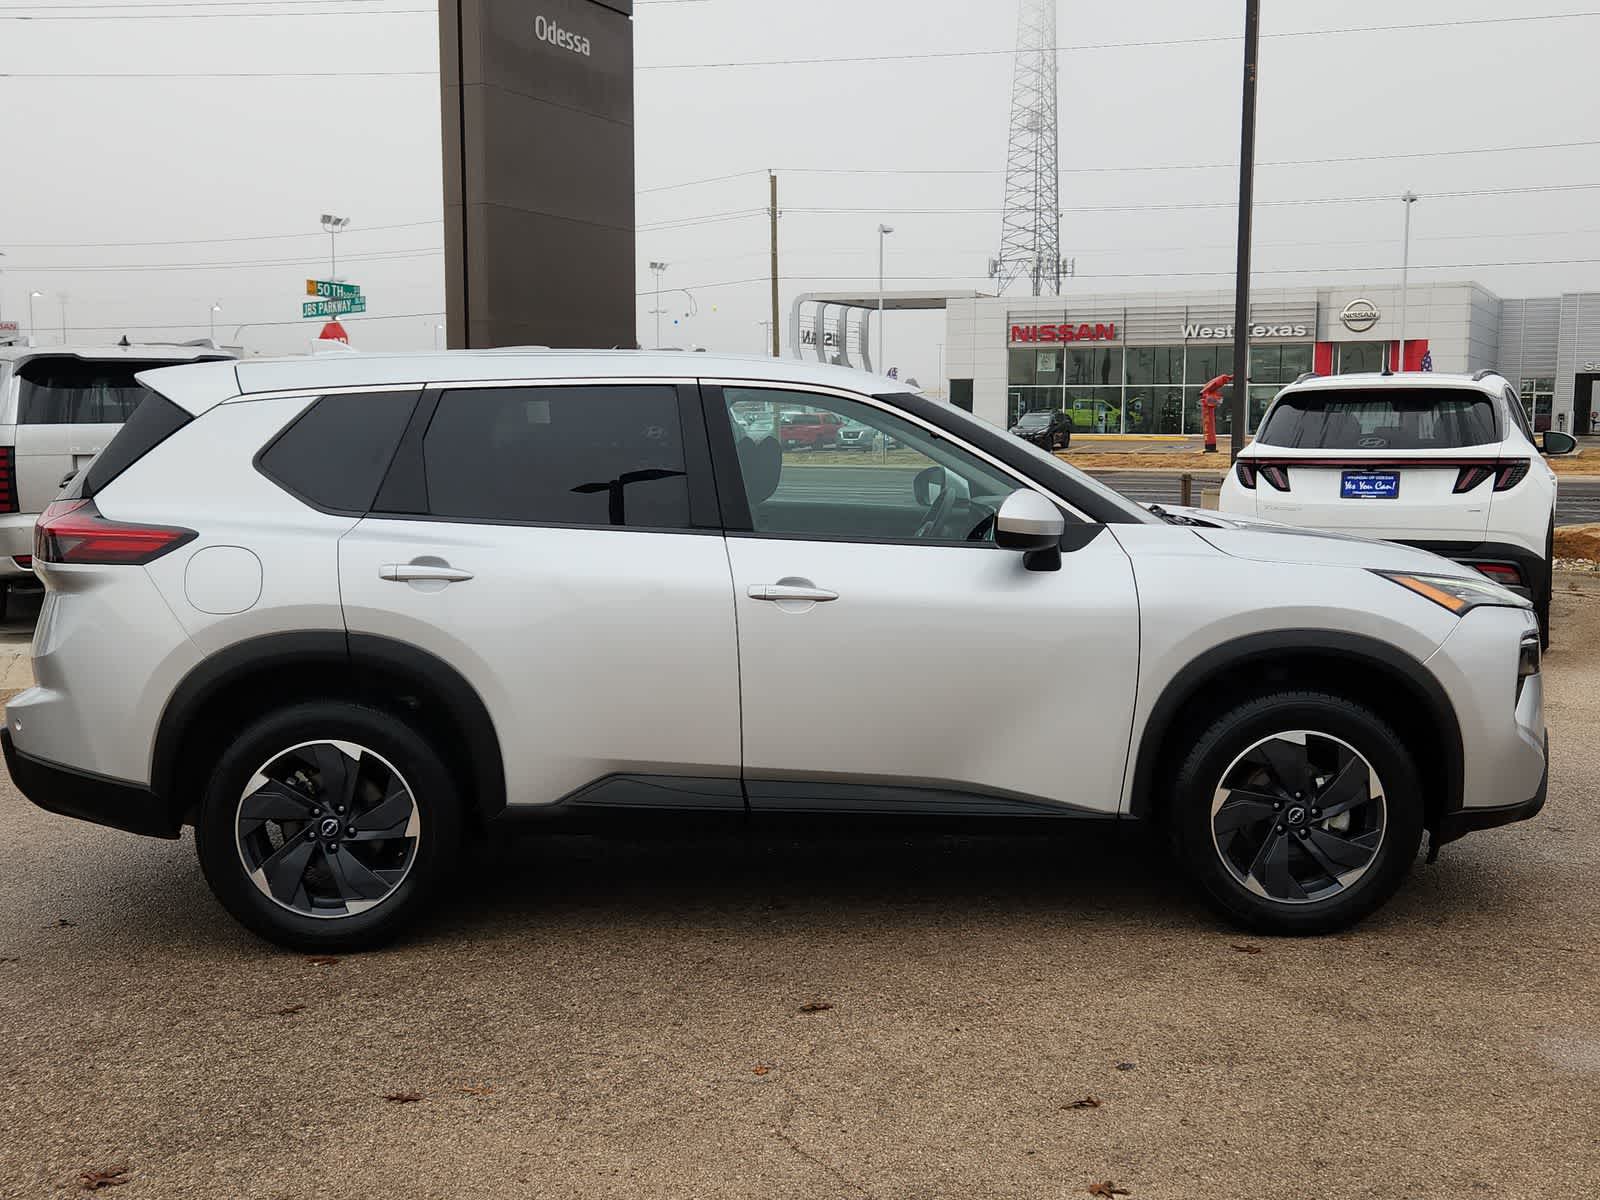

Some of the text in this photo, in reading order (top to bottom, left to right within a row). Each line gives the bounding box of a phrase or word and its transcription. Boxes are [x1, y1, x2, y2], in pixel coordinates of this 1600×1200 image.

[535, 15, 591, 56] Odessa
[303, 303, 317, 316] JBS
[318, 299, 352, 314] PARKWAY
[1345, 311, 1378, 319] NISSAN
[1011, 323, 1115, 342] NISSAN
[1181, 323, 1233, 338] West
[1344, 480, 1396, 490] Yes You Can!
